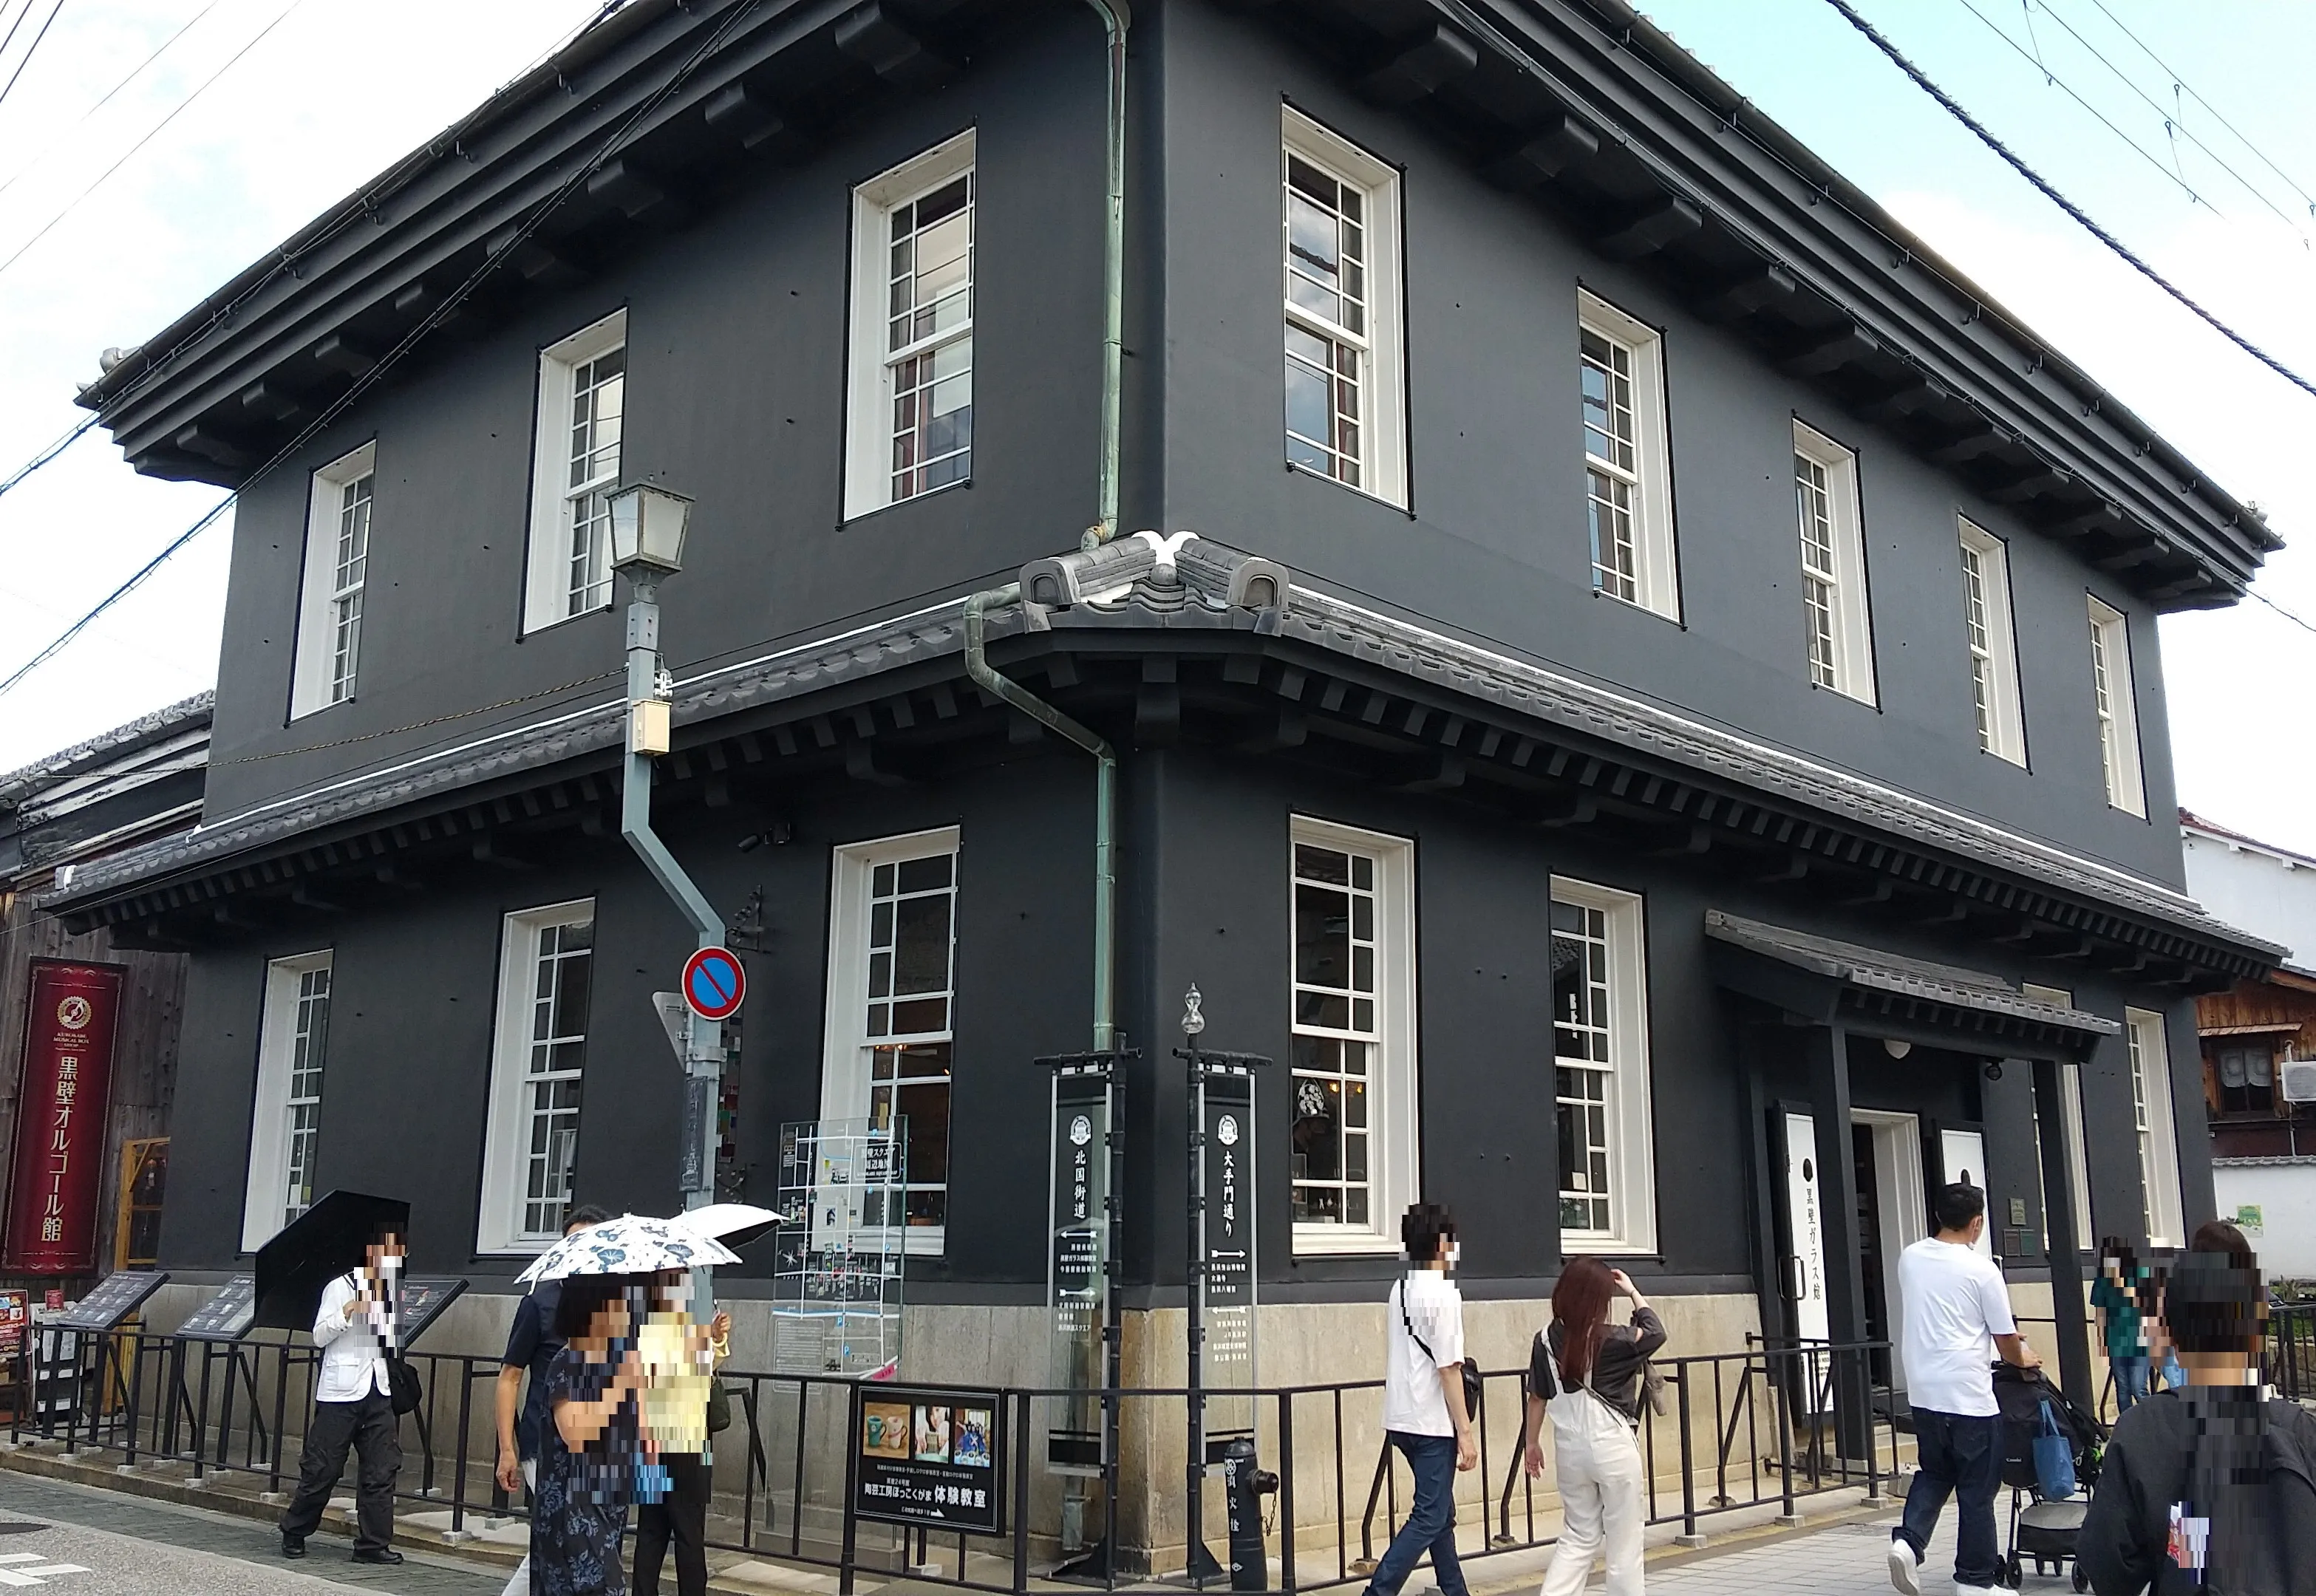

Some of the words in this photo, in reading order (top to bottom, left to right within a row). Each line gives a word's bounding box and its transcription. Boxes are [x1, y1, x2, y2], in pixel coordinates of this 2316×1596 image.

[40, 1056, 78, 1242] 黒壁オルゴール館
[1074, 1149, 1086, 1219] 北国街道
[1222, 1150, 1235, 1238] 大手門通り
[1806, 1188, 1821, 1301] 黒壁ガラス館
[864, 1482, 932, 1501] 陶芸工房ほっこくがま
[934, 1484, 986, 1509] 体験教室
